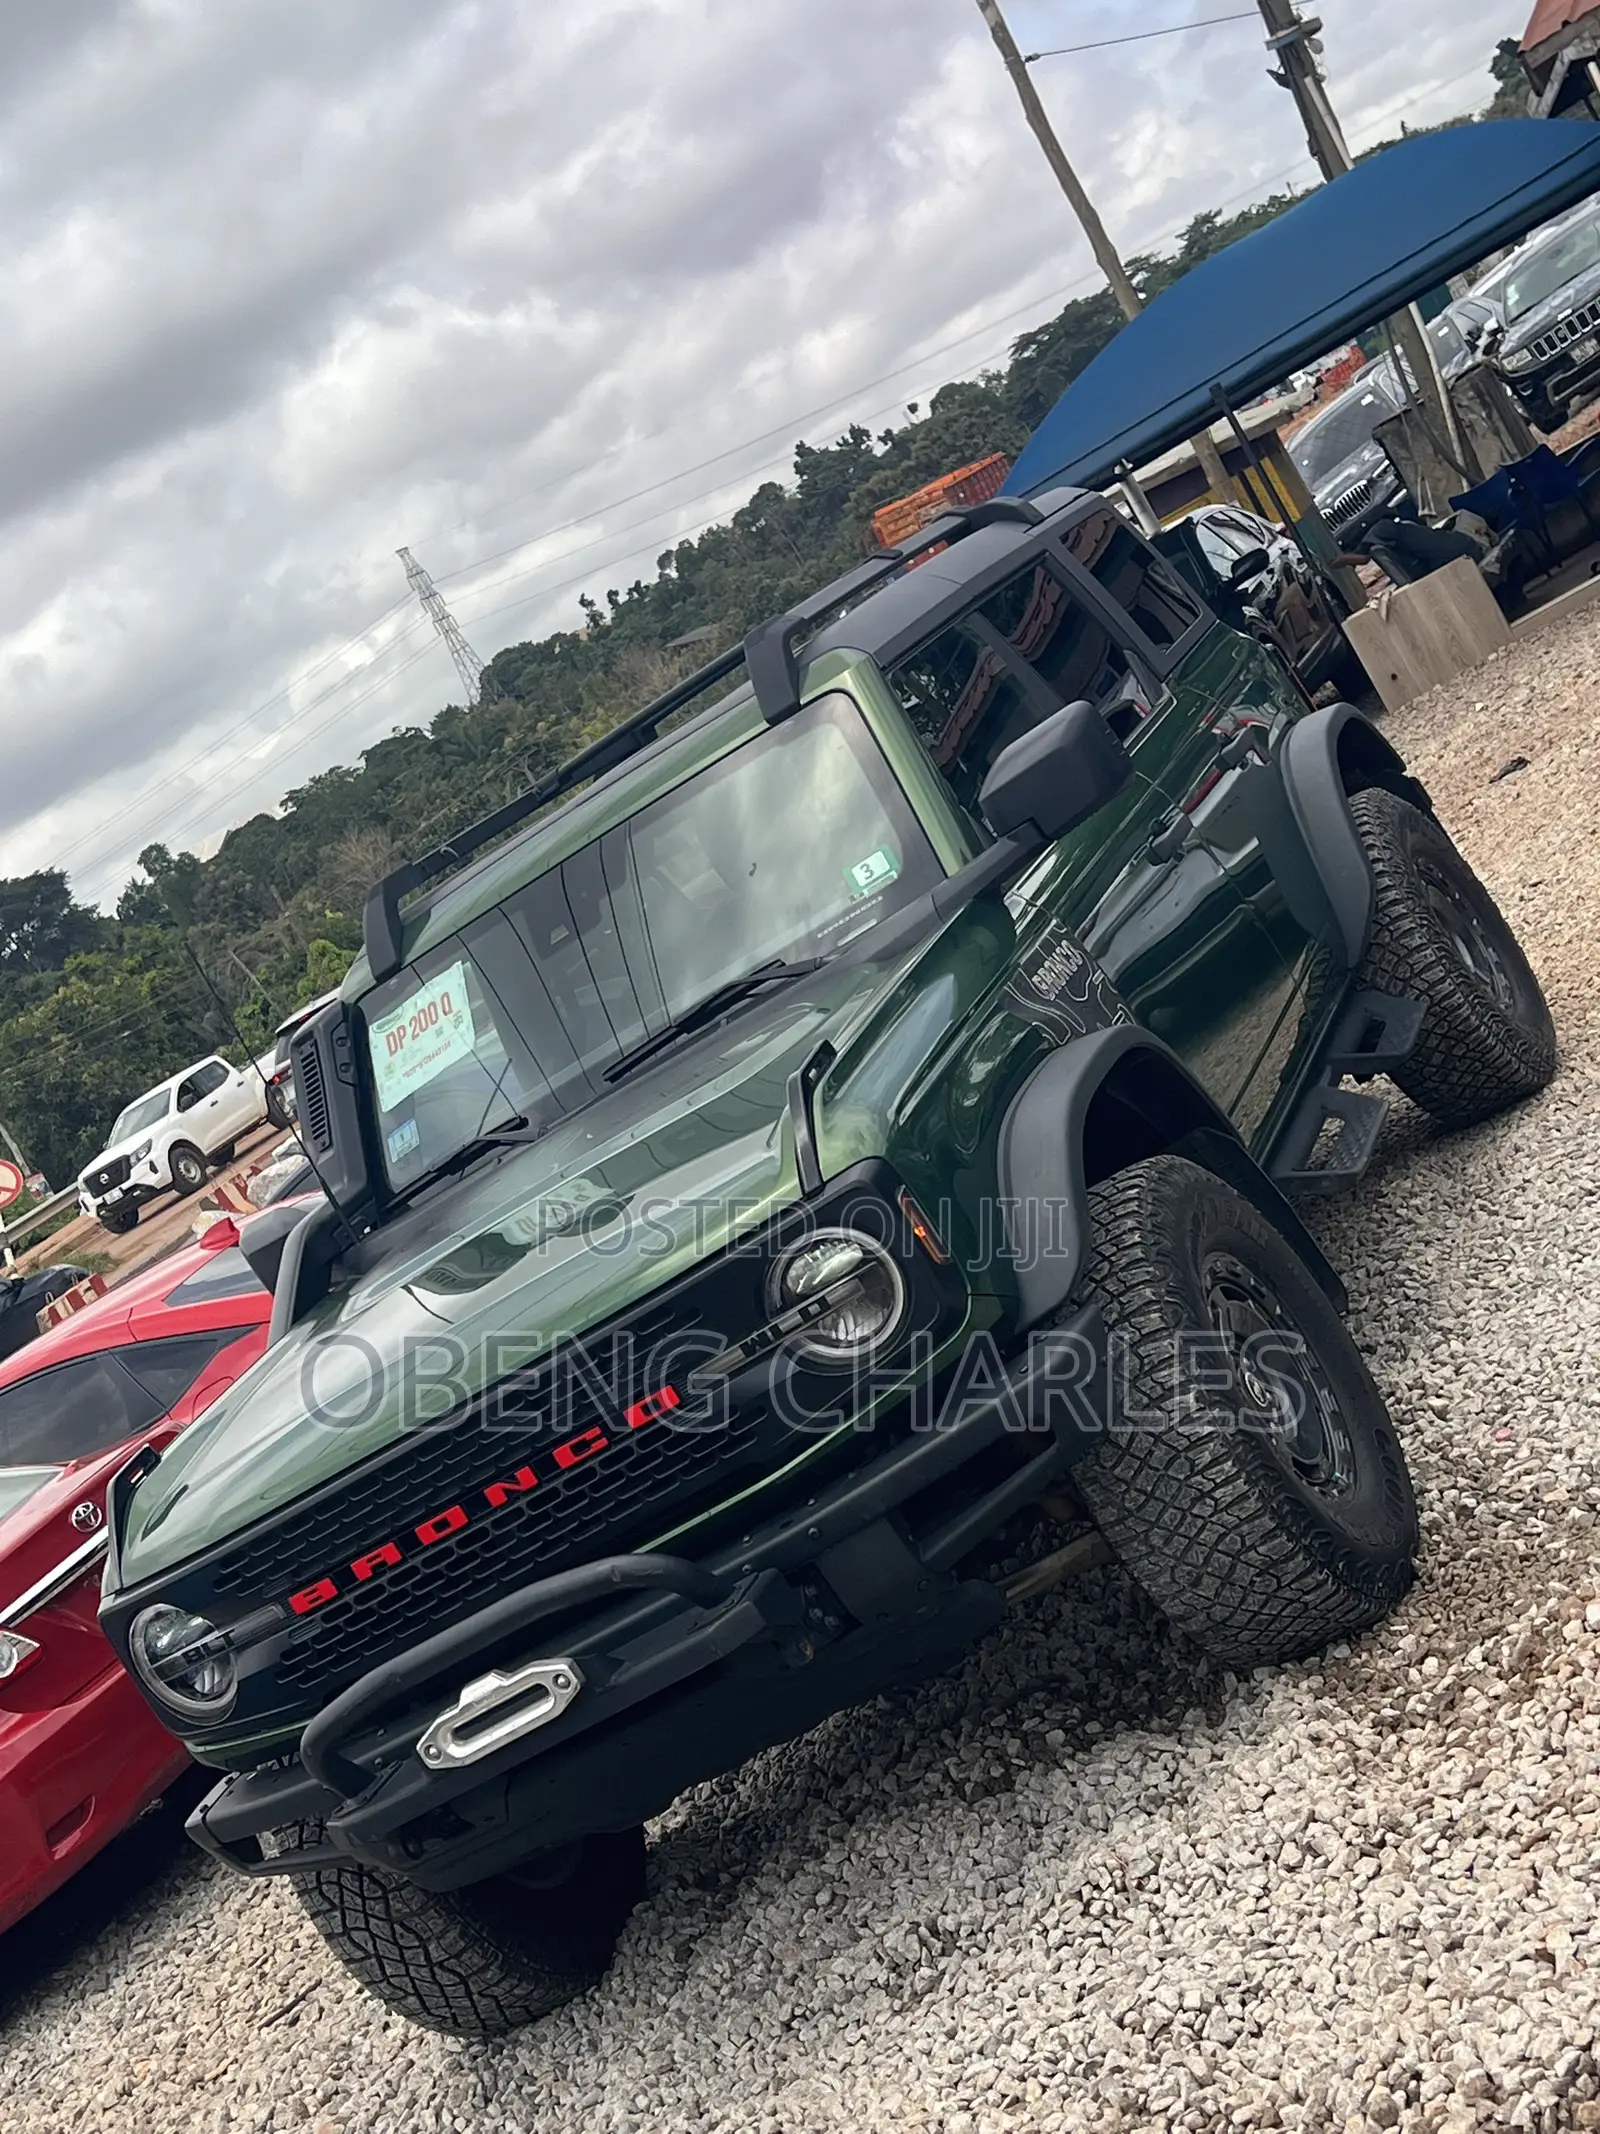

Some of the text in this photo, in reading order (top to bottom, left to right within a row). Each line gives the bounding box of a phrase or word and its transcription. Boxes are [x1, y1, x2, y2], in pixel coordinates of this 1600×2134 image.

[860, 863, 874, 880] 3
[1031, 940, 1083, 1000] BRONCO
[385, 1025, 406, 1057] DP
[409, 1001, 439, 1040] 200
[288, 1384, 681, 1616] BRONCO
